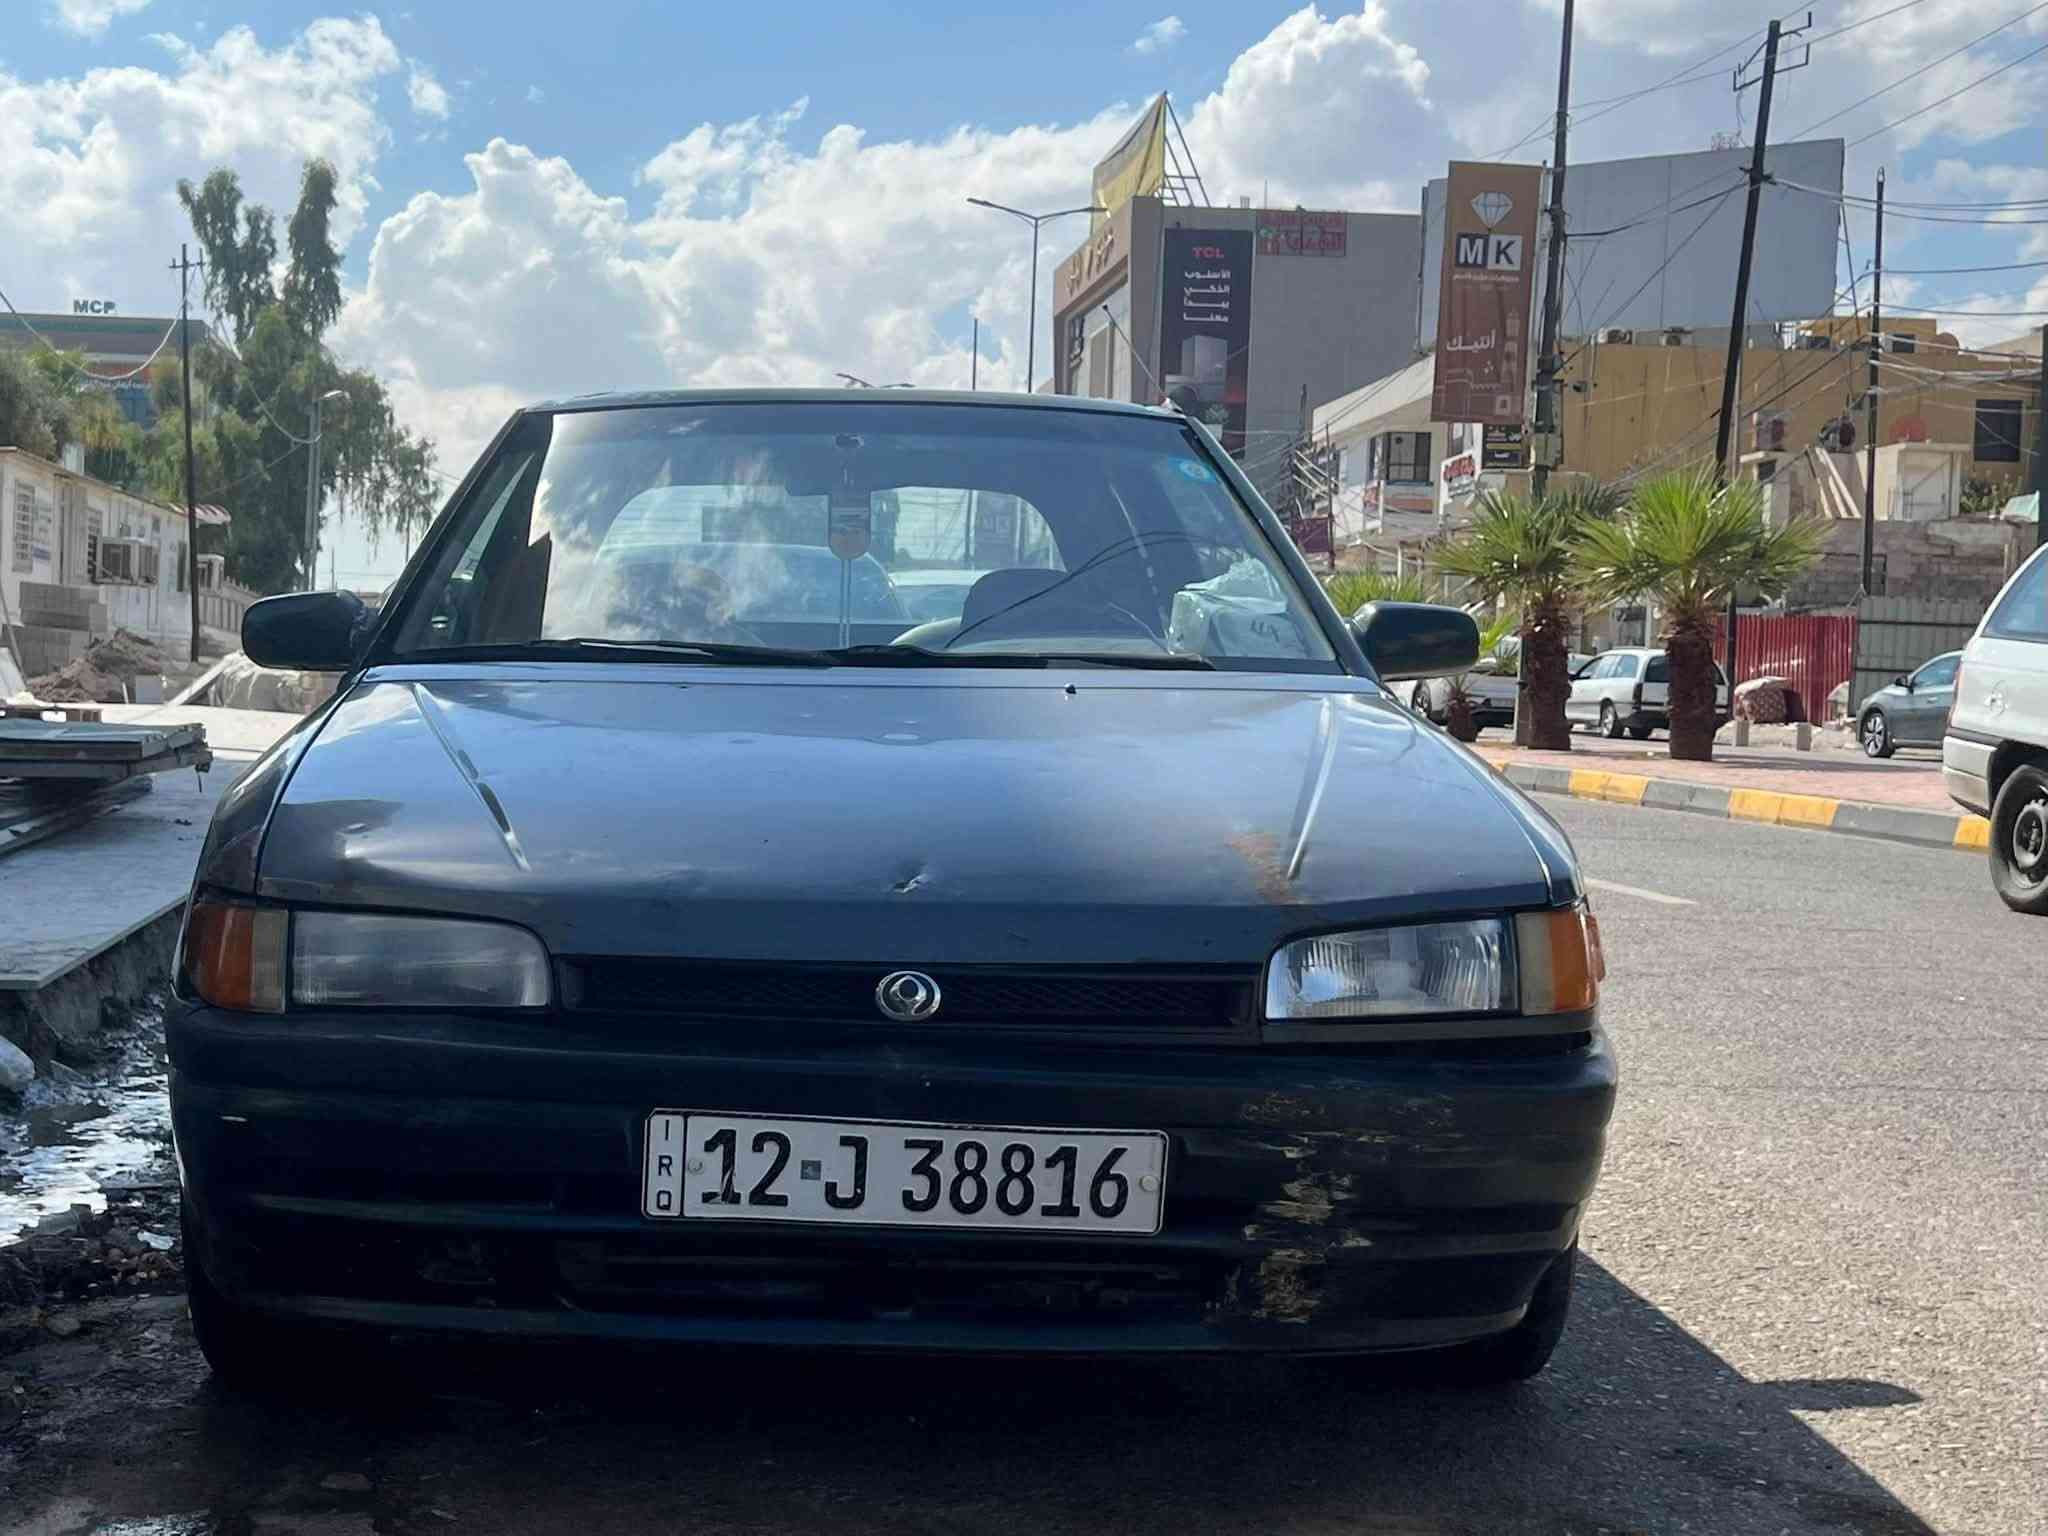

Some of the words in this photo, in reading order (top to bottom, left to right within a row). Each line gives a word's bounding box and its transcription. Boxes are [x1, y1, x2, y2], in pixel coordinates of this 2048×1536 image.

[1192, 247, 1225, 258] TCL
[73, 299, 116, 314] MCP
[702, 1128, 792, 1207] 12
[902, 1138, 1130, 1219] 38816
